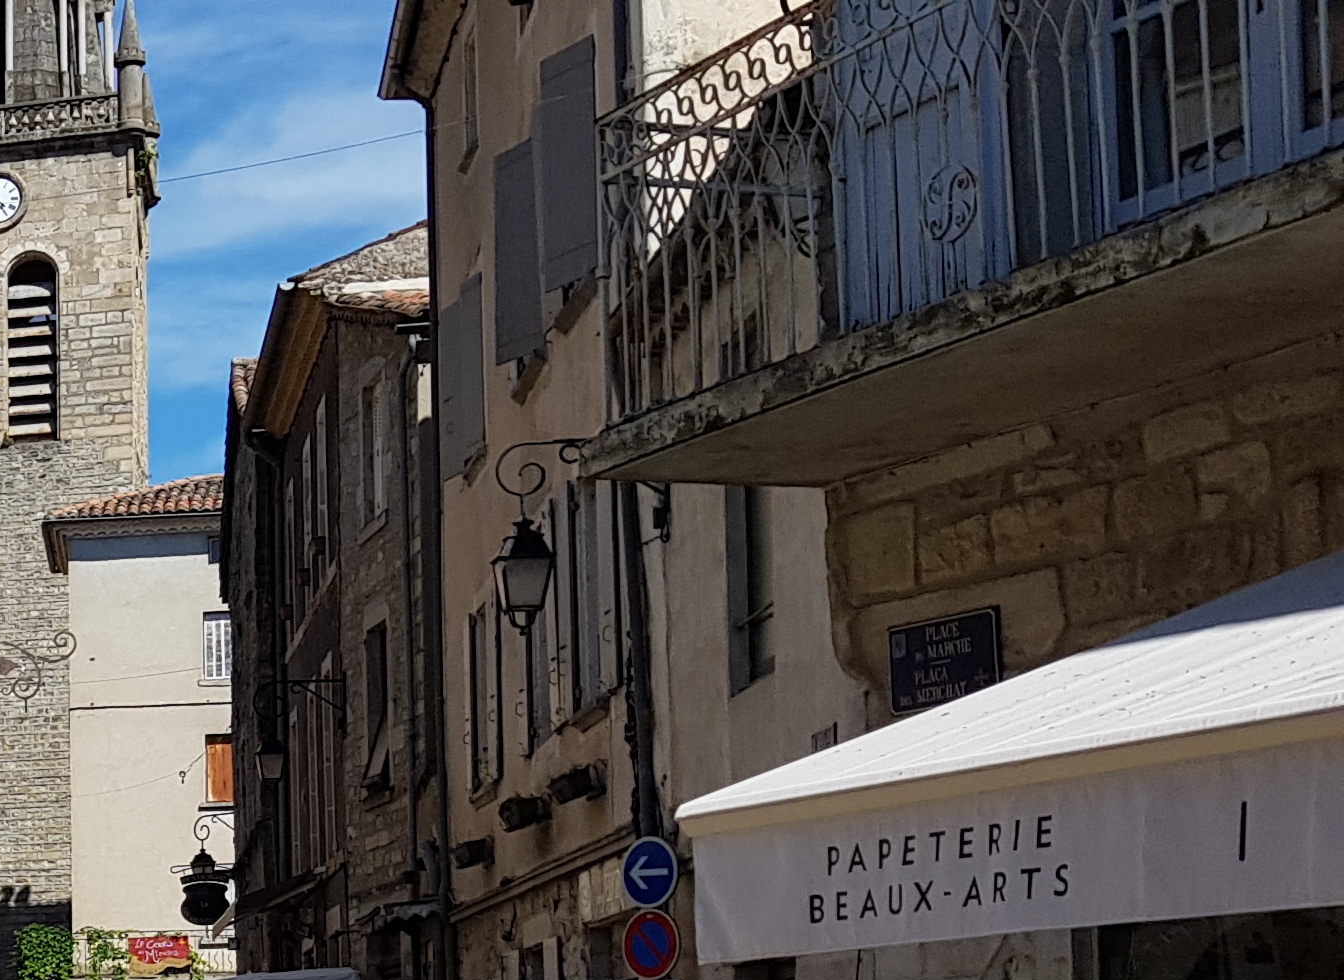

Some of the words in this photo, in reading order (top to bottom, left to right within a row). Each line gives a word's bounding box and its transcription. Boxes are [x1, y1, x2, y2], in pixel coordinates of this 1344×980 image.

[925, 621, 960, 642] PLACE
[826, 815, 1053, 876] PAPETERIE
[809, 863, 1069, 924] BEAUX-ARTS
